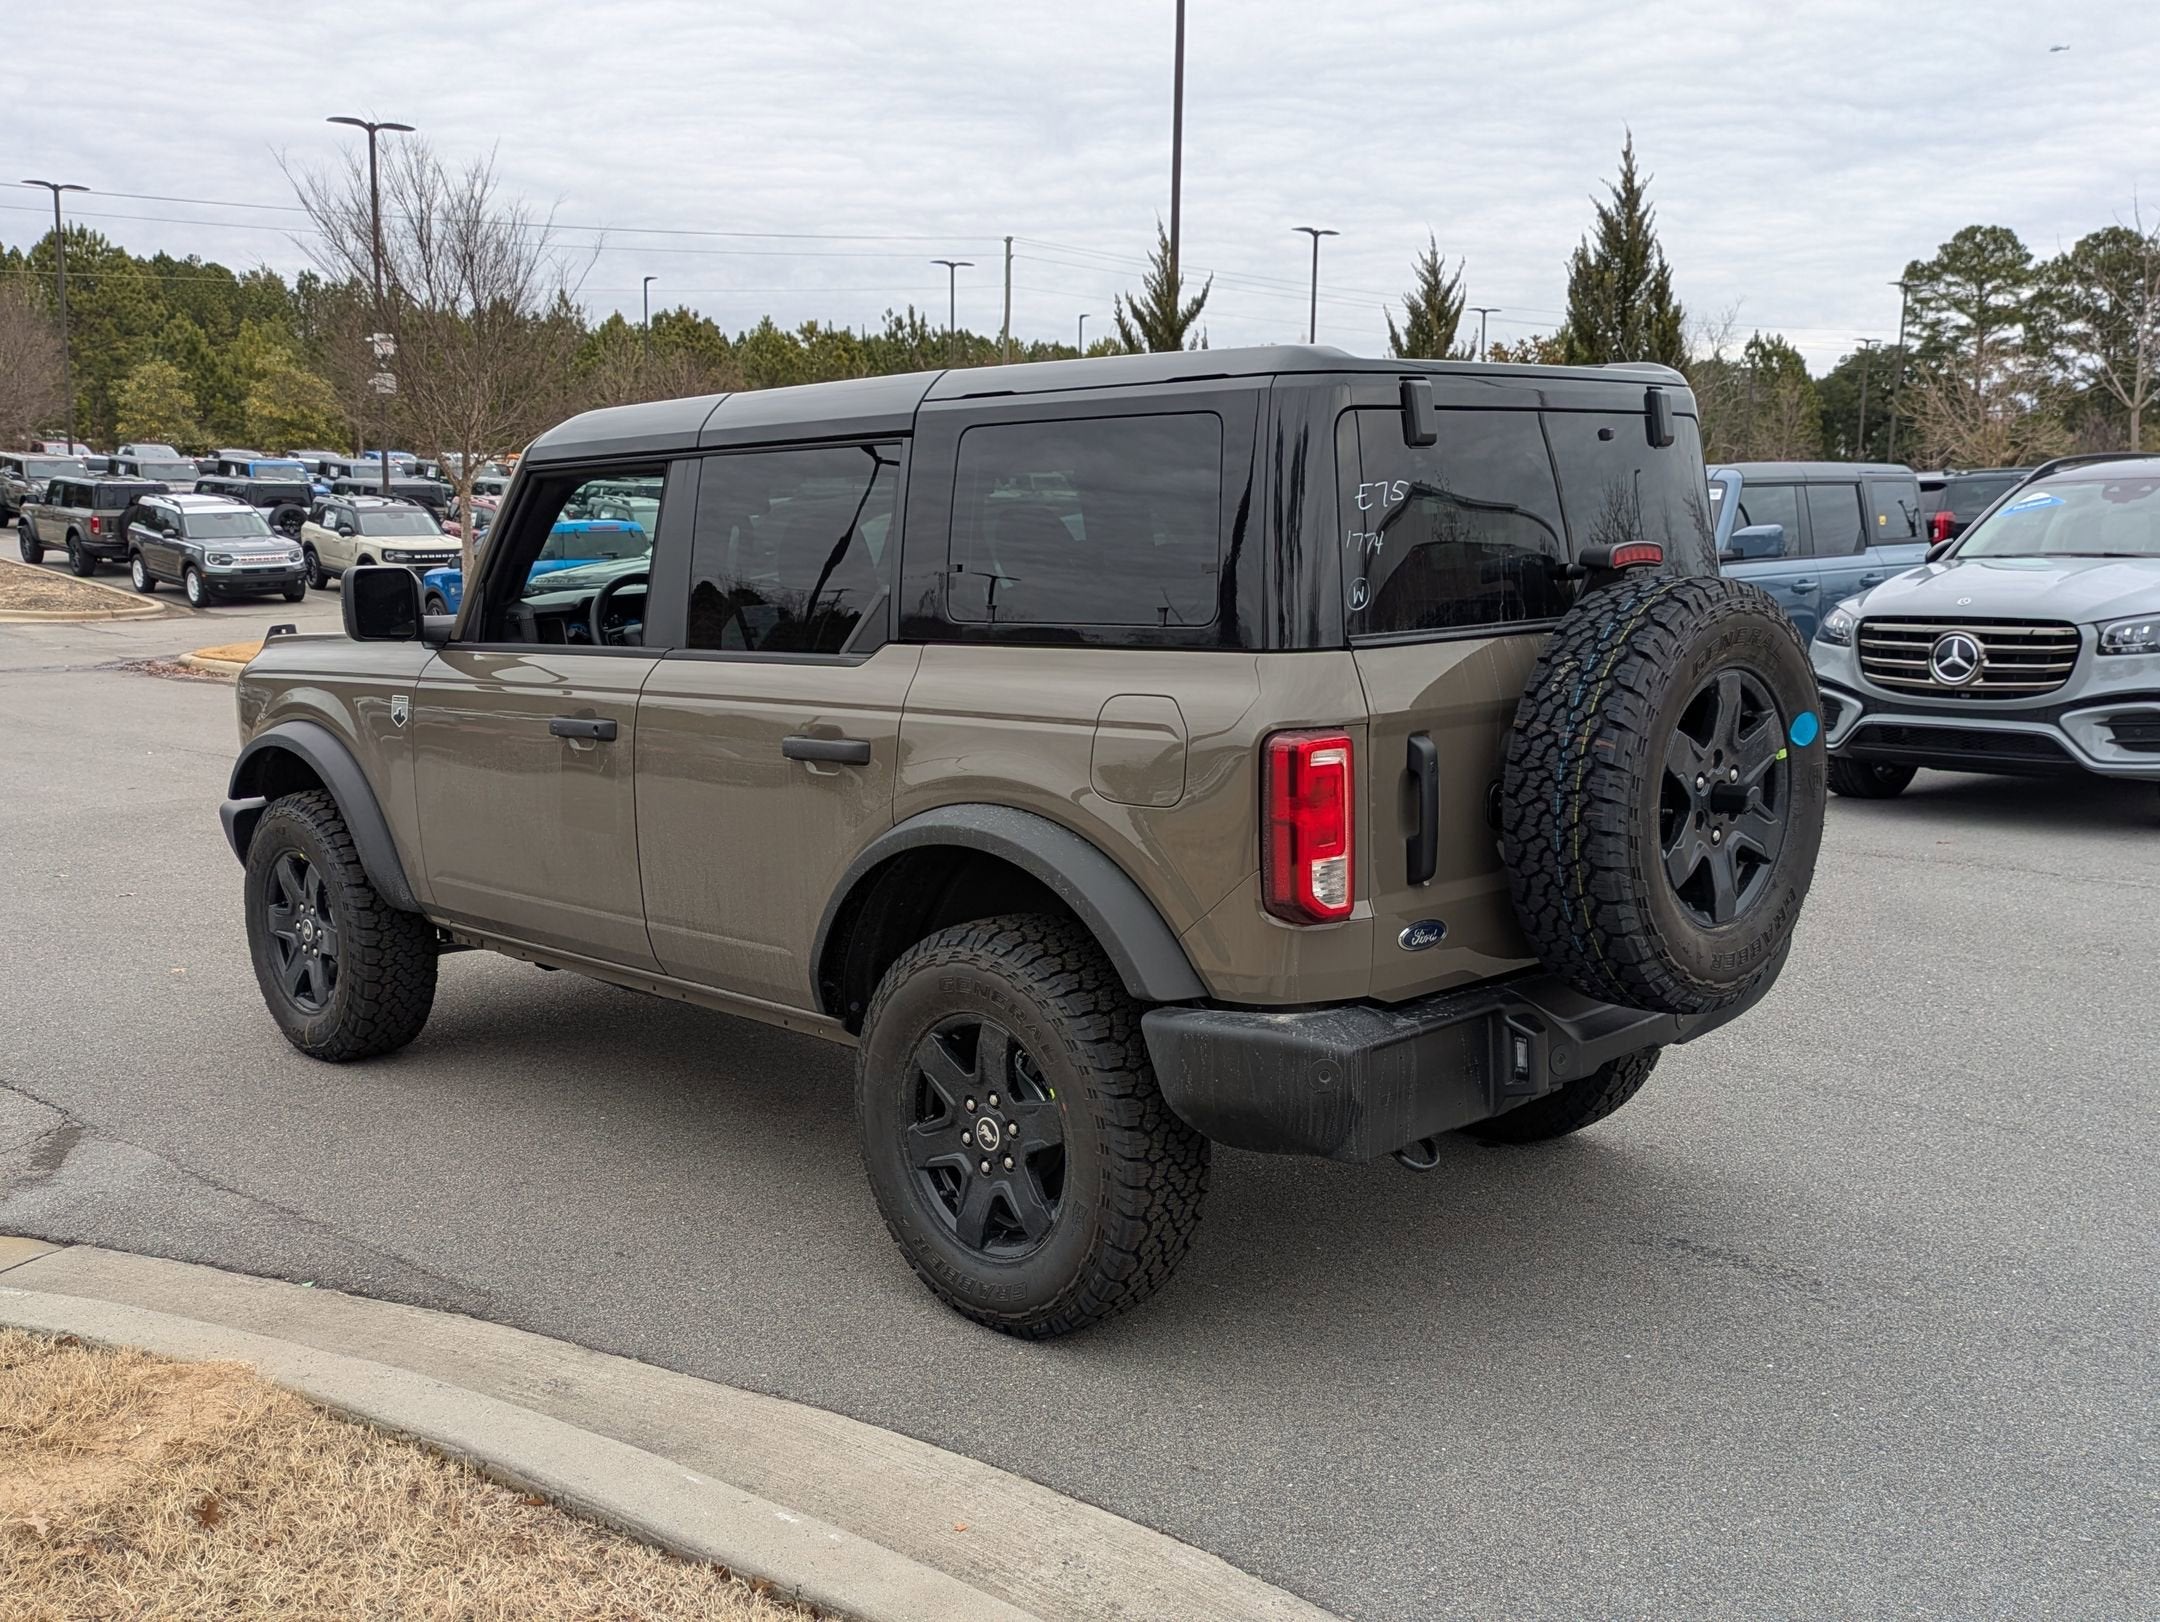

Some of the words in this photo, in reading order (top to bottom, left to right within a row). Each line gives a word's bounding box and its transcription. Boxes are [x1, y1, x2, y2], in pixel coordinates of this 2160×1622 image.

[1354, 480, 1409, 510] E75
[1346, 530, 1384, 555] 1774
[1692, 627, 1782, 681] GENERAL
[1411, 928, 1437, 945] Ford
[1711, 887, 1797, 971] GRABBER
[939, 975, 1056, 1065] GENERAL
[912, 1233, 1028, 1302] GRABBER
